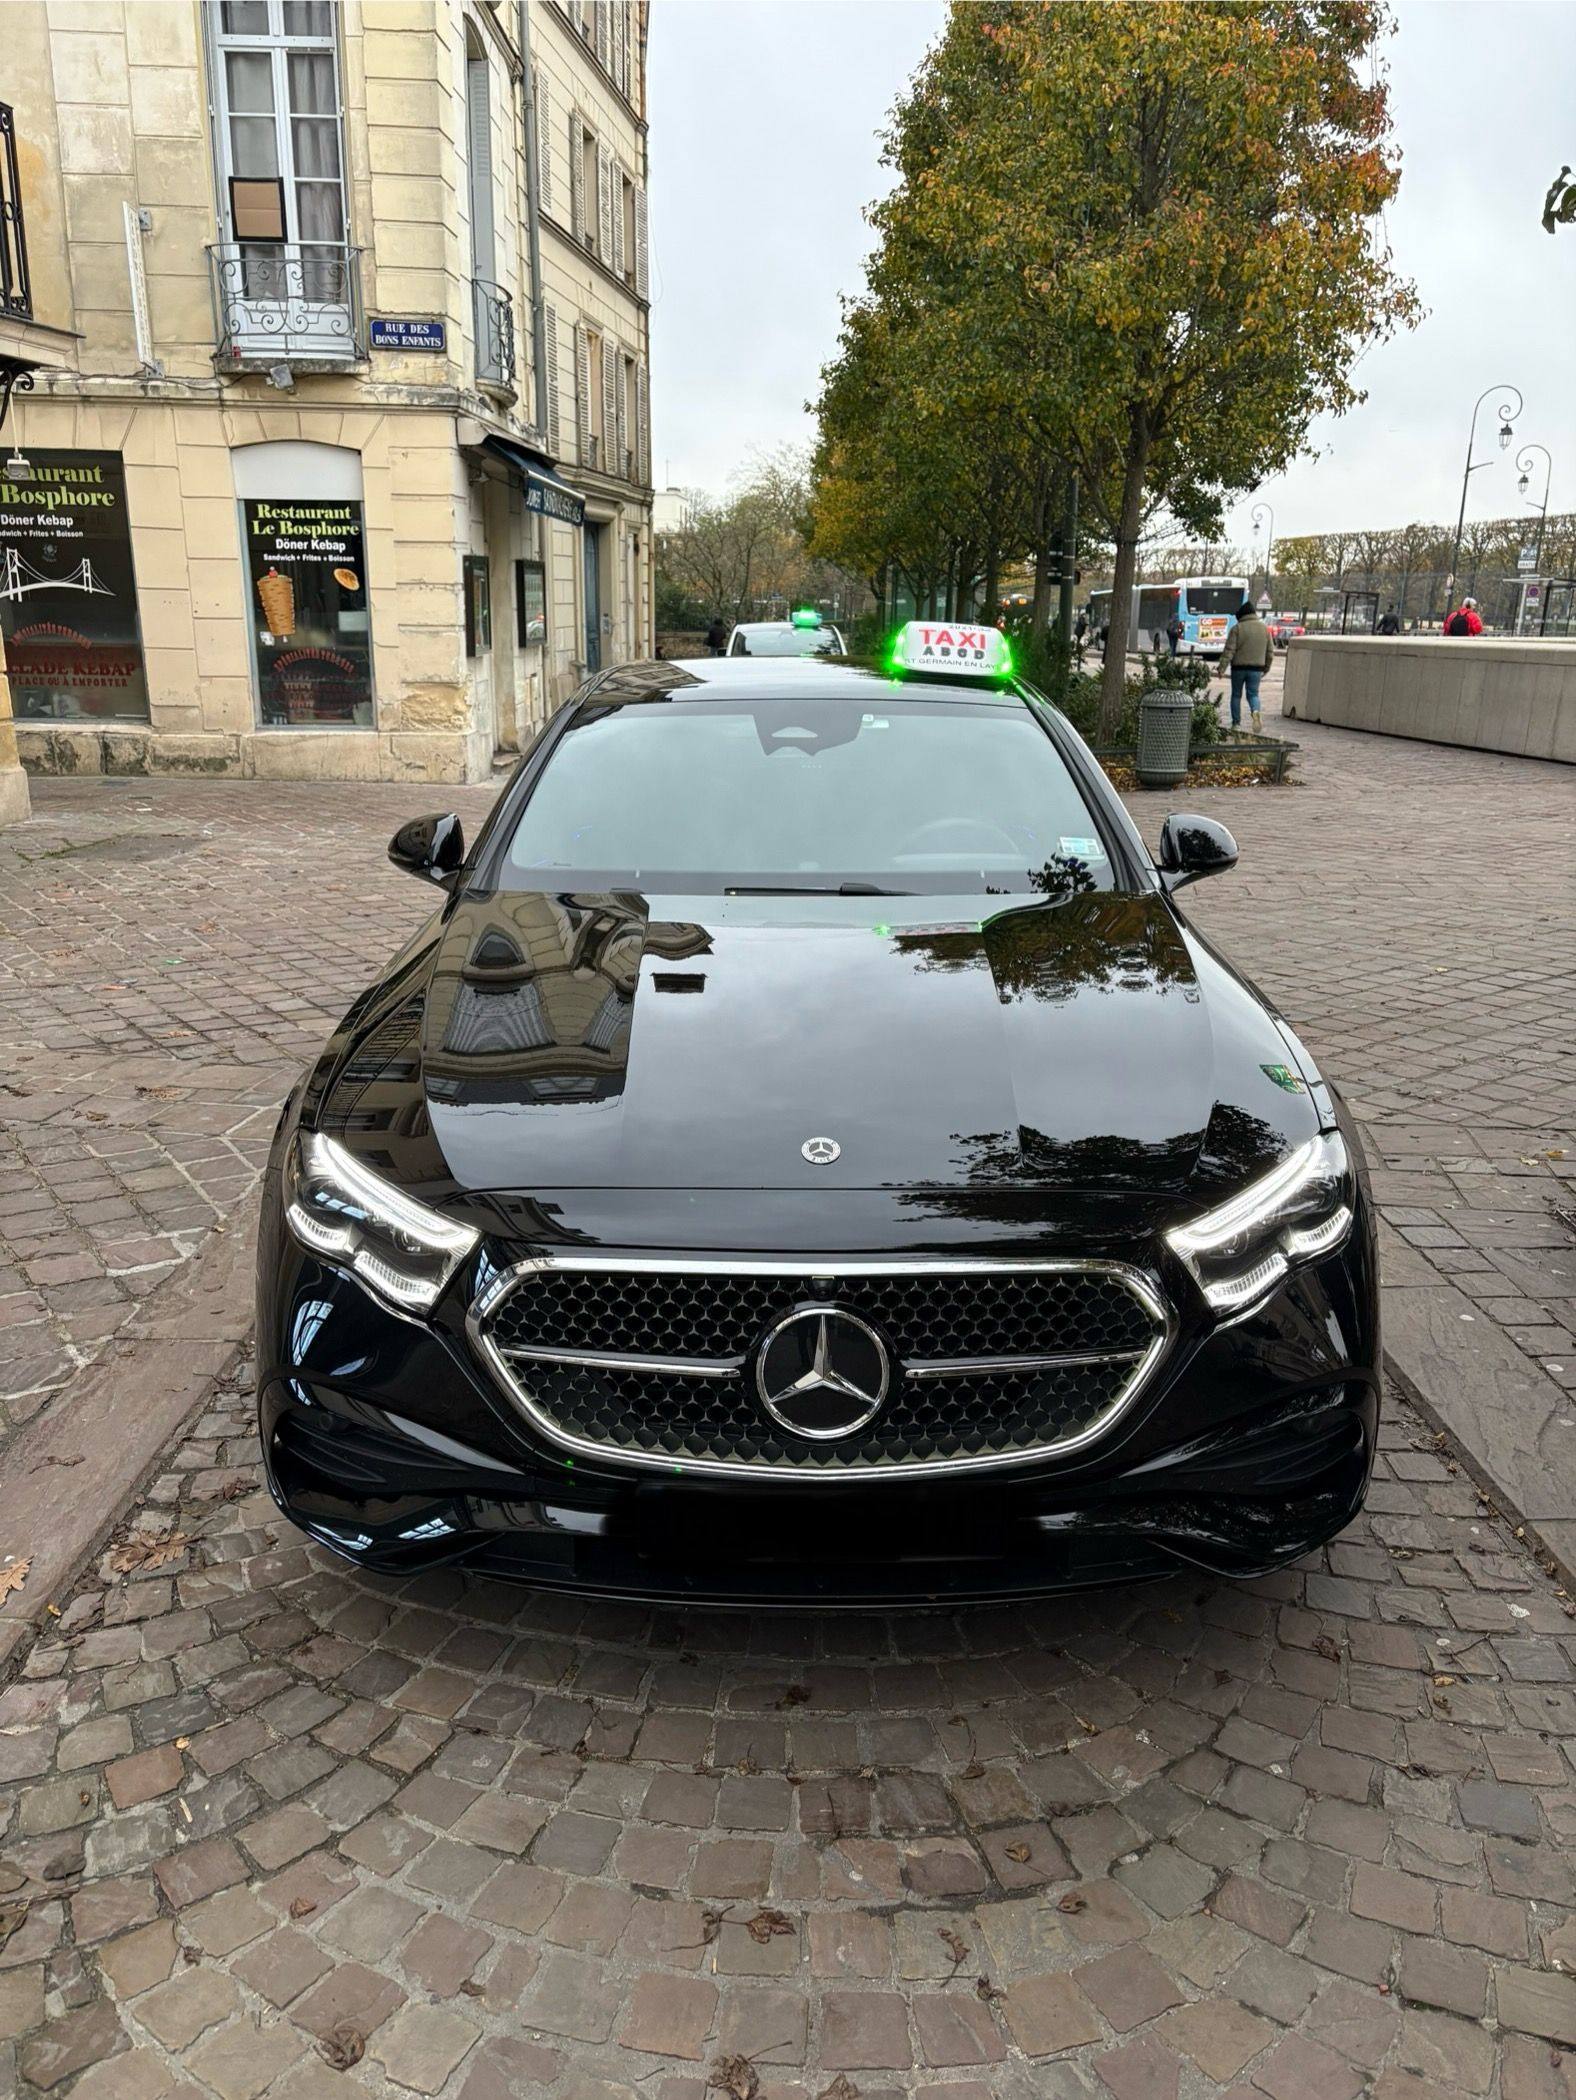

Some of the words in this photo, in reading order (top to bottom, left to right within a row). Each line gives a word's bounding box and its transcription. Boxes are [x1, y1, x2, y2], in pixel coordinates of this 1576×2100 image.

[385, 323, 406, 333] RUE
[410, 324, 430, 334] DES
[375, 335, 399, 345] BONS
[401, 336, 441, 347] ENFANTS
[0, 484, 115, 510] Bosphore
[257, 504, 352, 520] Restaurant
[1, 513, 35, 526] Döner
[37, 514, 74, 528] Kebap
[253, 521, 275, 535] Le
[279, 521, 360, 539] Bosphore
[276, 538, 308, 550] Döner
[311, 539, 346, 553] Kebap
[263, 553, 296, 562] Sandwich
[302, 554, 321, 562] Frites
[918, 628, 986, 650] TAXI
[923, 646, 935, 656] A
[941, 647, 951, 657] B
[974, 650, 985, 660] D
[73, 662, 136, 676] KEBAP
[919, 658, 962, 666] GERMAIN
[12, 676, 45, 686] PLACE
[72, 677, 128, 688] EMPORTER
